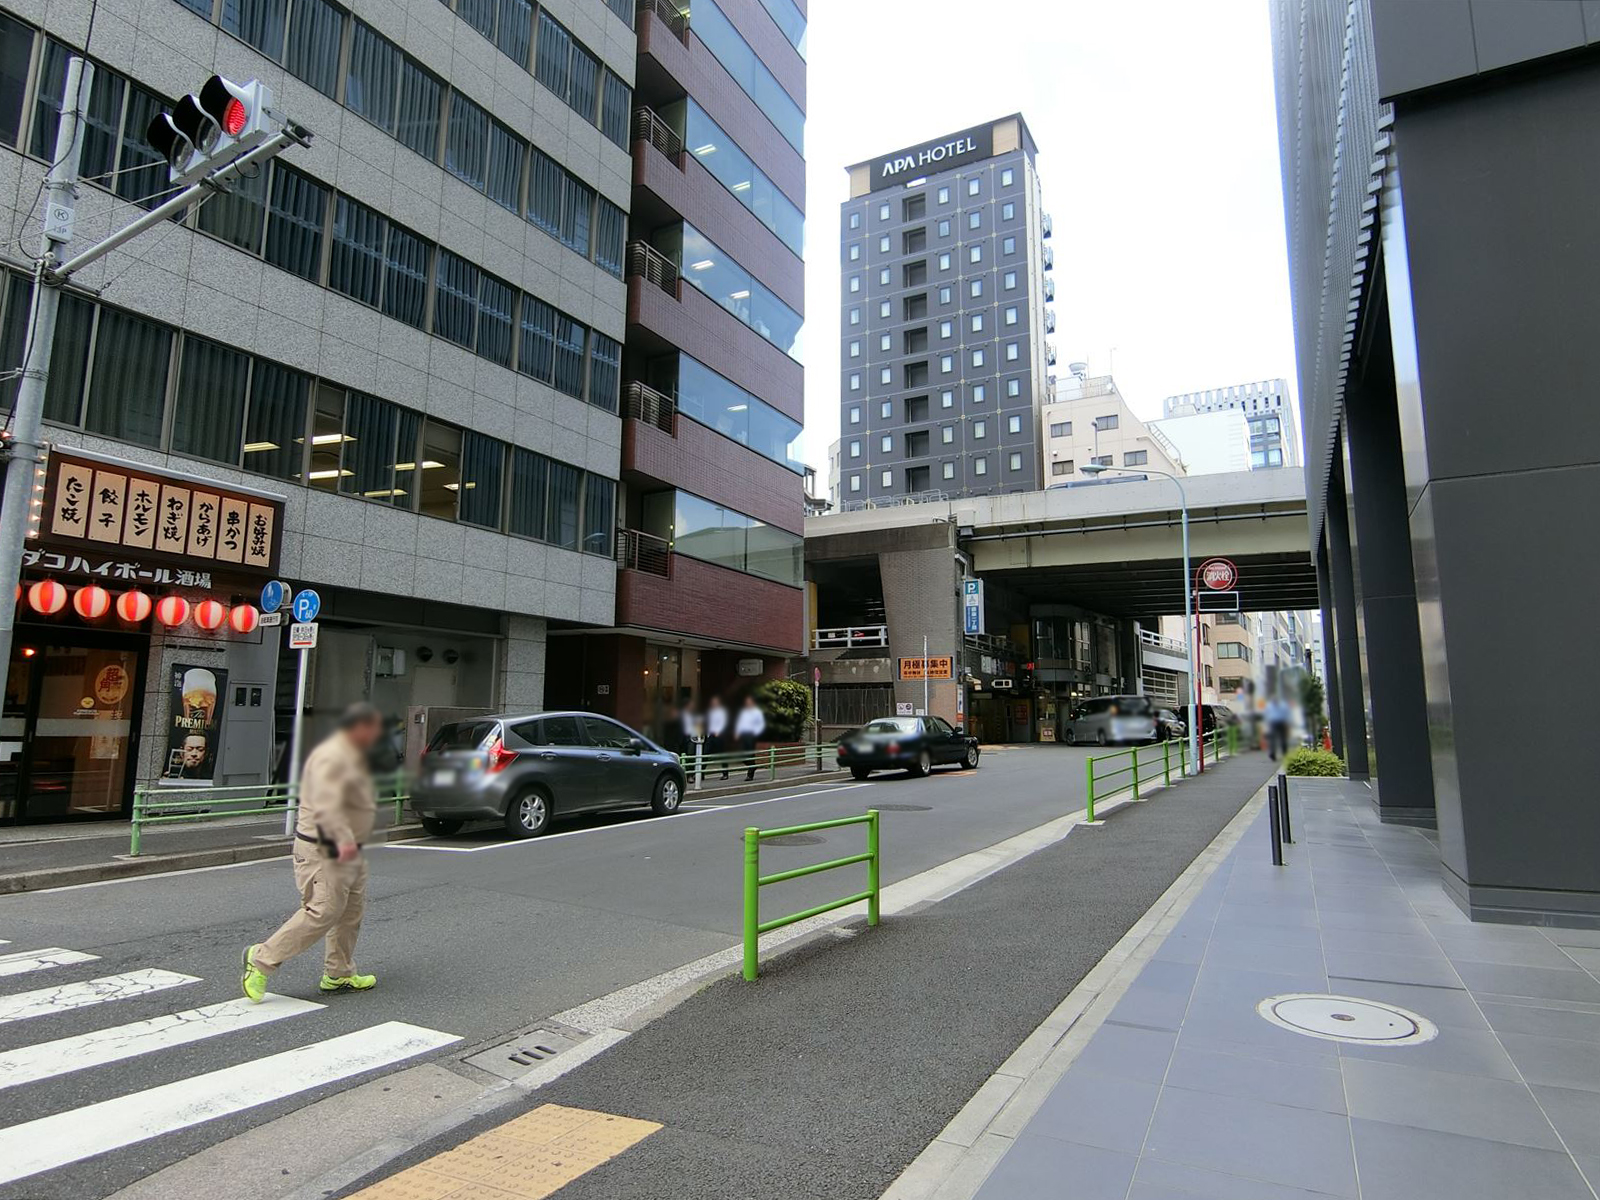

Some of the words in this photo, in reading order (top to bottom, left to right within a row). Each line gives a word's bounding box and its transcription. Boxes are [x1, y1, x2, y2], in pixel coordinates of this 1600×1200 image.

[882, 155, 916, 177] APA
[918, 137, 977, 166] HOTEL
[61, 476, 84, 525] たこ焼
[98, 487, 119, 529] 餃子
[132, 489, 153, 537] ホルモン
[163, 496, 184, 542] ねぎ焼
[196, 501, 214, 547] からあげ
[224, 510, 241, 551] 串かつ
[250, 513, 268, 558] お好み焼
